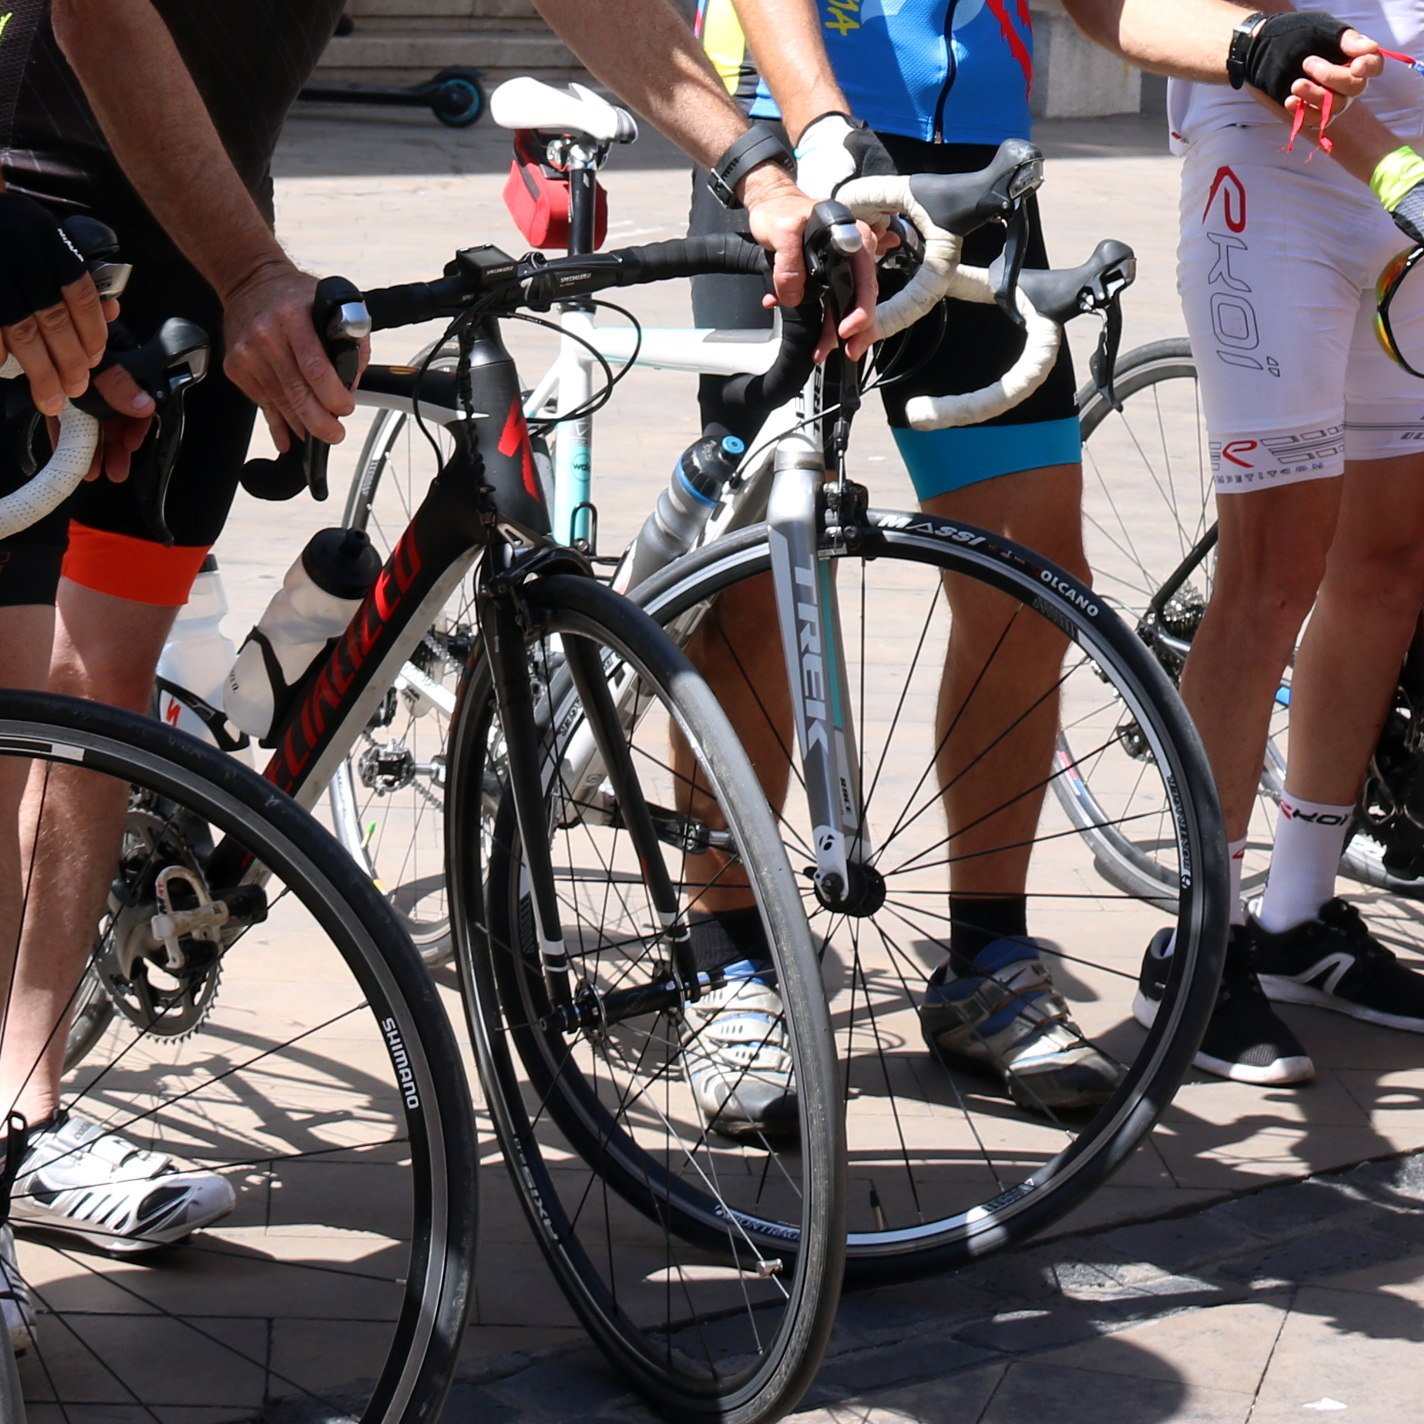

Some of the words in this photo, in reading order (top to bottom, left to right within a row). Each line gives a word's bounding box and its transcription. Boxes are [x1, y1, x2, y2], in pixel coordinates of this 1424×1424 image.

[877, 512, 986, 546] MASSI
[792, 553, 833, 761] TREK
[381, 1016, 419, 1111] SHIMANO
